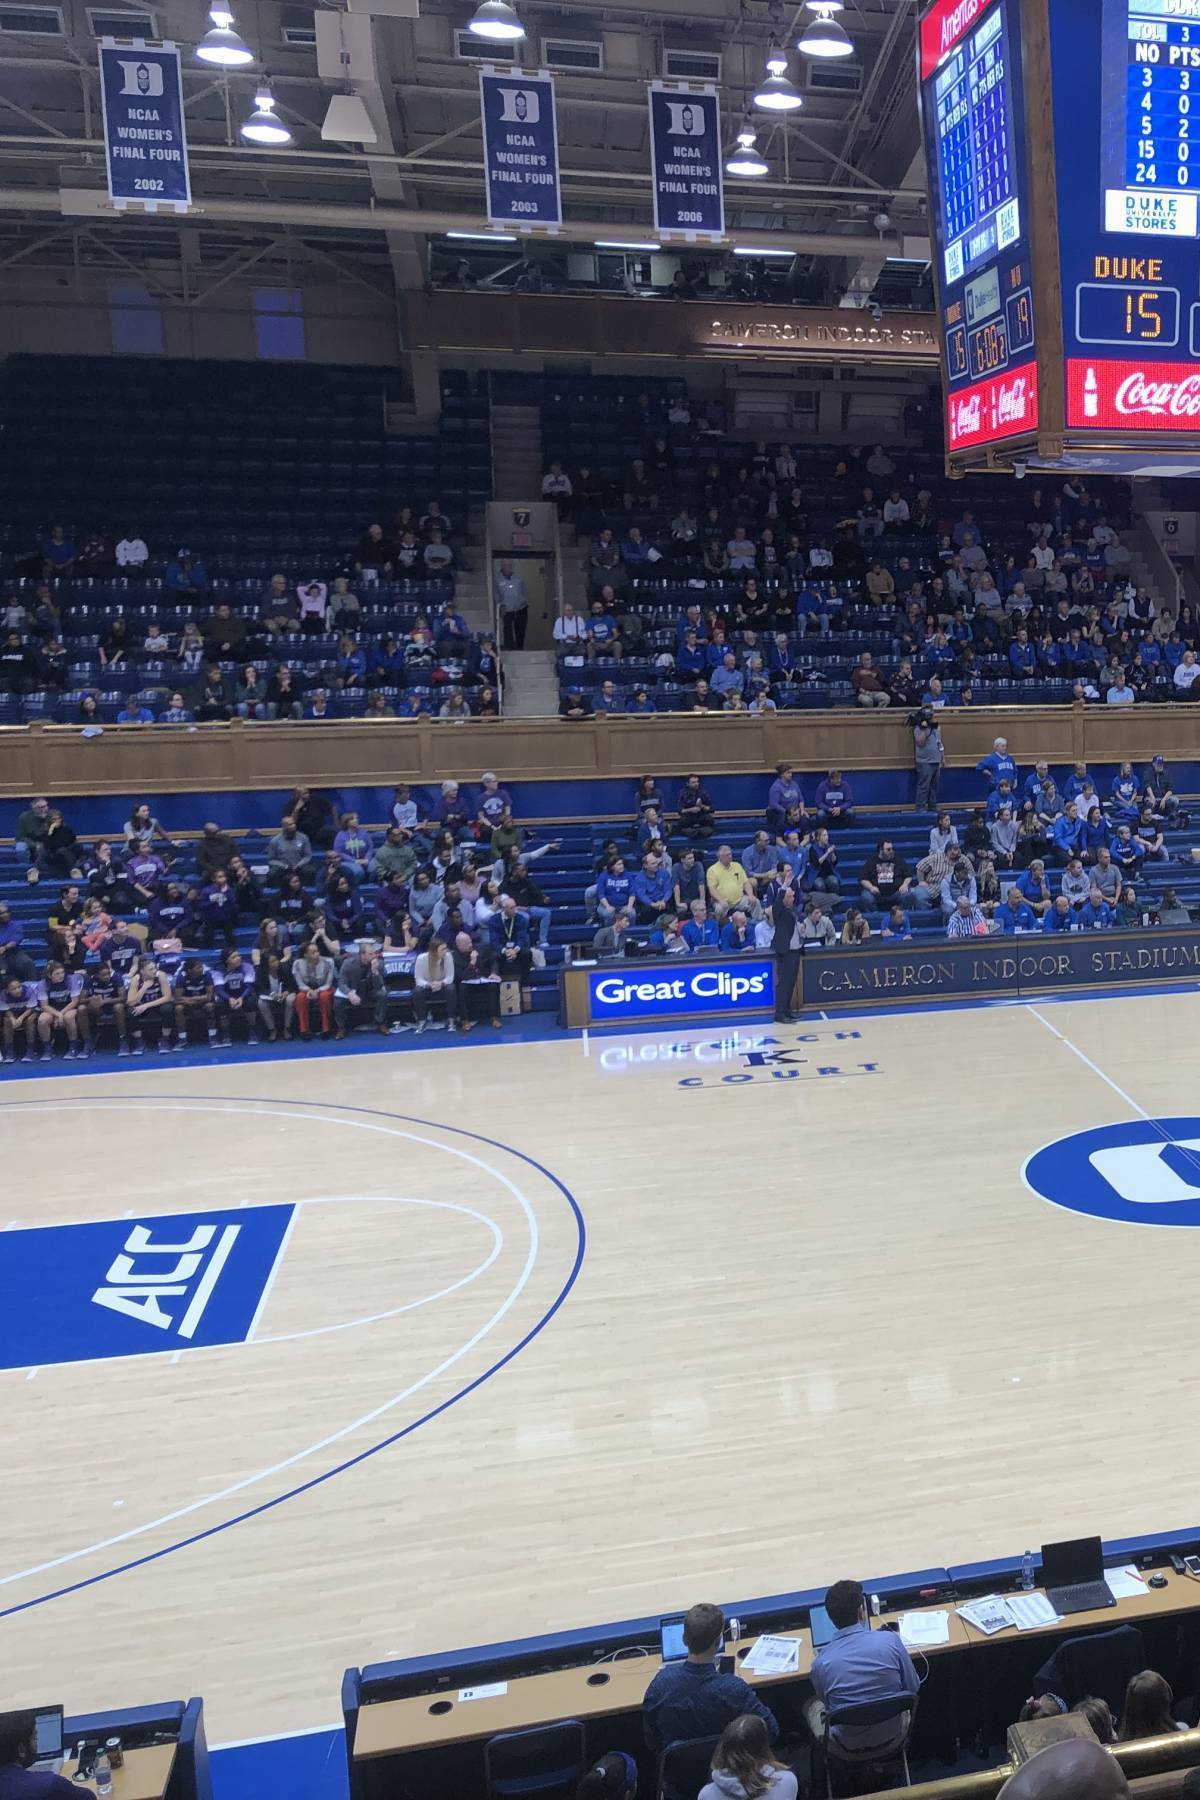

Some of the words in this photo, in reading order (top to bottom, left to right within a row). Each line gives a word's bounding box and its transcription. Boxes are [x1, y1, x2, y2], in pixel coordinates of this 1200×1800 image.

[1181, 26, 1190, 42] 3
[1135, 42, 1160, 63] NO
[1169, 46, 1200, 67] PTS
[1142, 68, 1152, 87] 3
[1179, 71, 1190, 90] 3
[1141, 92, 1152, 111] 4
[1178, 94, 1190, 114] 0
[128, 108, 160, 121] NCAA
[118, 127, 172, 141] WOMEN'S
[1141, 115, 1152, 135] 5
[1178, 119, 1189, 138] 2
[506, 134, 536, 147] NCAA
[113, 147, 146, 159] FINAL
[150, 149, 181, 161] FOUR
[673, 146, 701, 158] NCAA
[1138, 139, 1155, 160] 15
[1177, 142, 1189, 162] 0
[496, 152, 547, 166] WOMEN'S
[492, 170, 522, 183] FINAL
[525, 173, 554, 185] FOUR
[664, 164, 711, 177] WOMEN'S
[1135, 163, 1157, 183] 24
[1177, 166, 1188, 185] 0
[134, 179, 164, 191] 2002
[659, 182, 688, 193] FINAL
[691, 184, 718, 195] FOUR
[511, 201, 538, 213] 2003
[1126, 196, 1177, 212] DUKE
[677, 211, 703, 222] 2006
[1126, 217, 1177, 230] STORES
[1095, 256, 1163, 281] DUKE
[1017, 297, 1029, 339] 19
[1127, 293, 1161, 338] 15
[712, 321, 808, 341] CAMERON
[817, 325, 893, 344] INDOOR
[976, 325, 999, 371] 6:08
[518, 513, 526, 524] 7
[384, 961, 412, 974] DUKE
[819, 963, 956, 991] CAMERON
[972, 955, 1074, 981] INDOOR
[1091, 945, 1200, 972] STADIUM
[595, 979, 686, 1003] Great
[691, 972, 764, 1001] Clips
[739, 1049, 808, 1068] K
[678, 1062, 879, 1087] COURT
[90, 1224, 218, 1331] ACC
